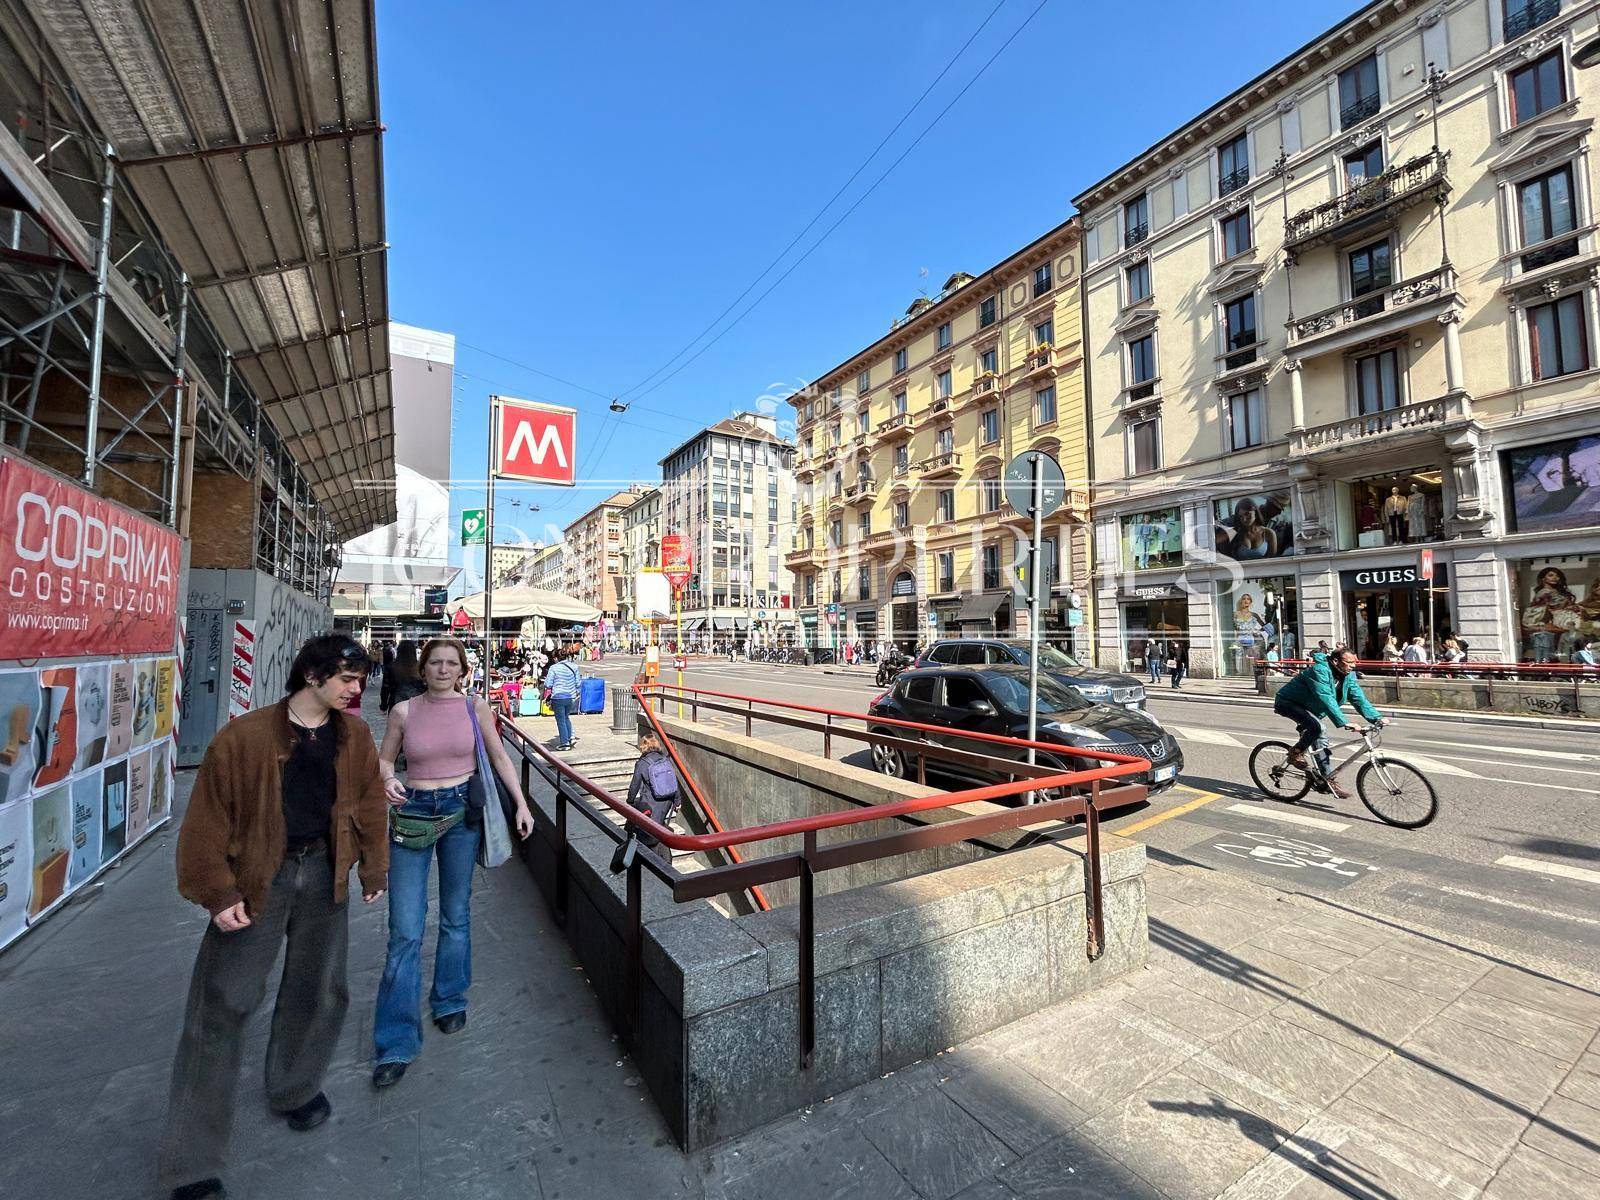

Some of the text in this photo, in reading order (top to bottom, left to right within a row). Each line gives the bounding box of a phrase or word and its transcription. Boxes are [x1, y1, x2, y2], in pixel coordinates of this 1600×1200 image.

[505, 420, 569, 468] M
[15, 491, 171, 591] COPRIMA
[1355, 569, 1428, 584] GUES
[1423, 557, 1433, 576] M
[9, 567, 171, 616] COSTRUZIONI
[8, 612, 89, 635] www.coprima.it
